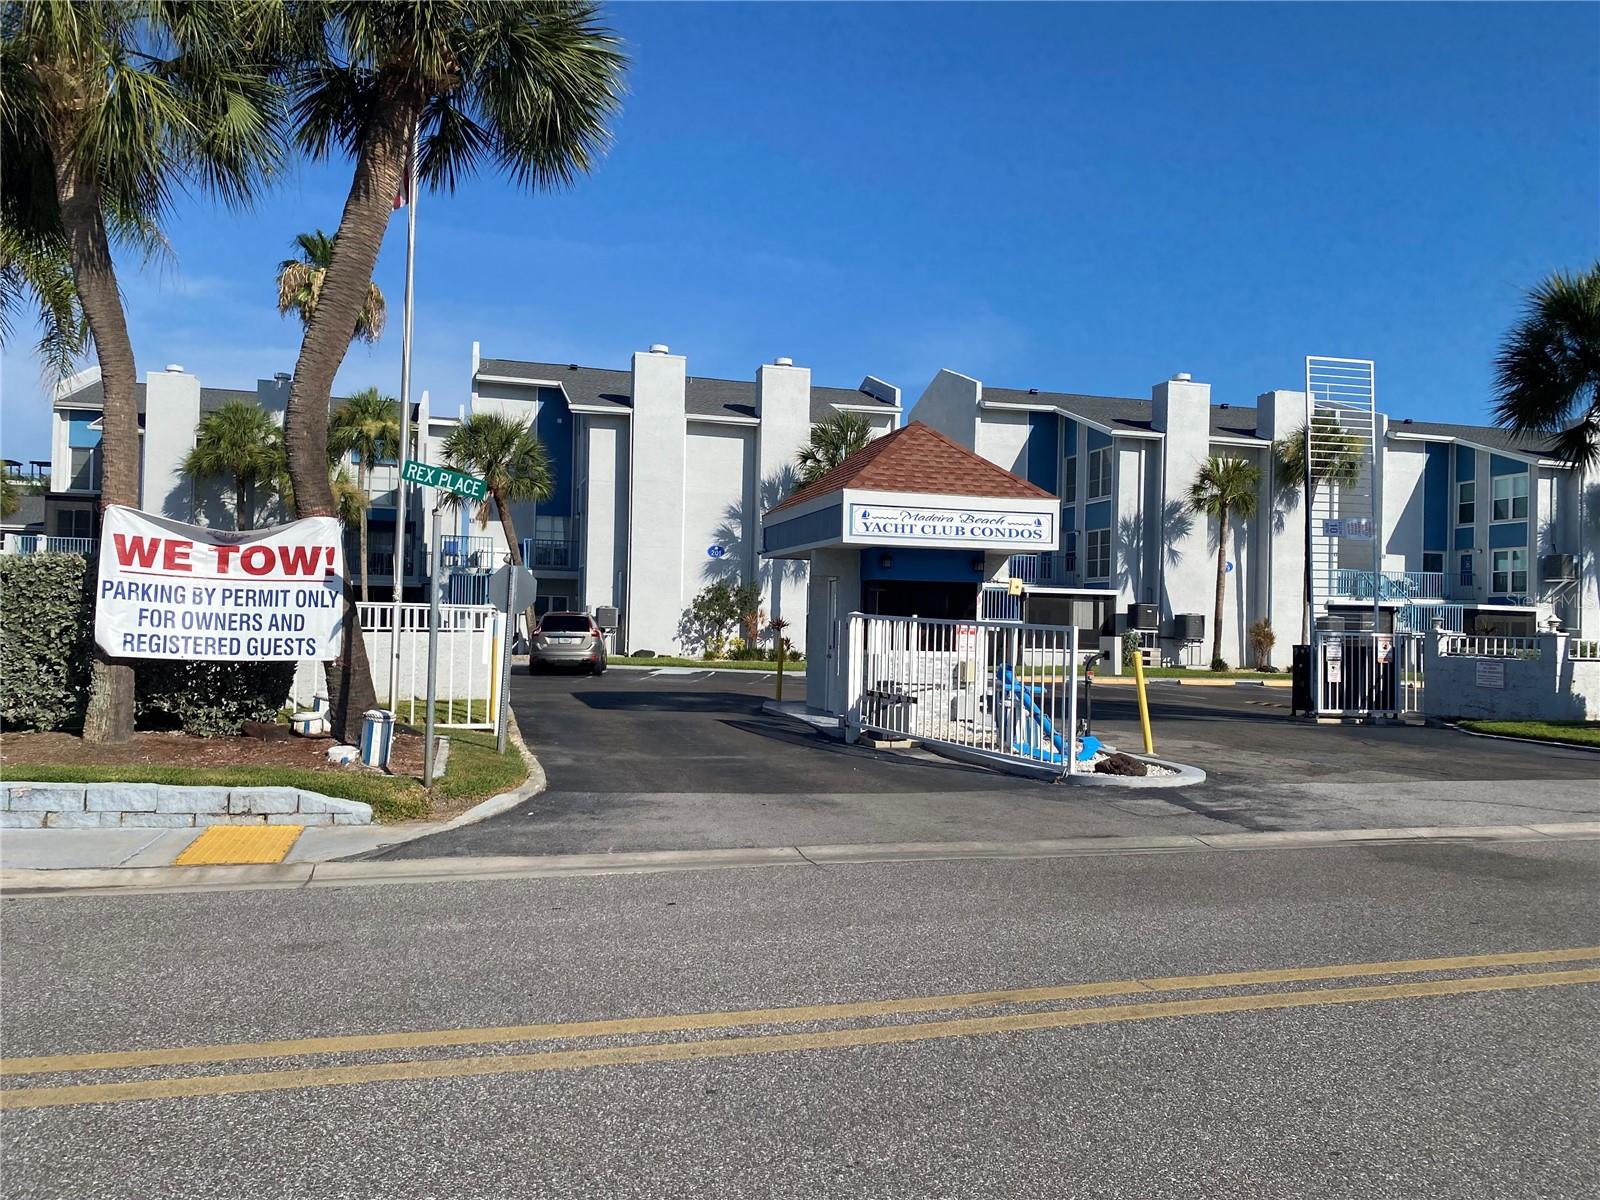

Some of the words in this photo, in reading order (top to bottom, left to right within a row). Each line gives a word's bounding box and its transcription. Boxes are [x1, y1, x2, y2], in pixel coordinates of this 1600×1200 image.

[406, 463, 435, 484] REX
[438, 472, 482, 496] PLACE
[899, 510, 954, 523] Madeira
[959, 512, 1006, 526] Beach
[861, 521, 918, 535] YACHT
[921, 524, 966, 537] CLUB
[970, 526, 1043, 540] CONDOS
[113, 533, 193, 572] WE
[208, 544, 336, 577] TOW!
[101, 580, 186, 605] PARKING
[192, 586, 216, 606] BY
[221, 588, 291, 608] PERMIT
[293, 589, 340, 609] ONLY
[138, 608, 176, 630] FOR
[181, 610, 263, 631] OWNERS
[268, 613, 305, 632] AND
[123, 633, 241, 656] REGISTERED
[246, 637, 316, 657] GUESTS
